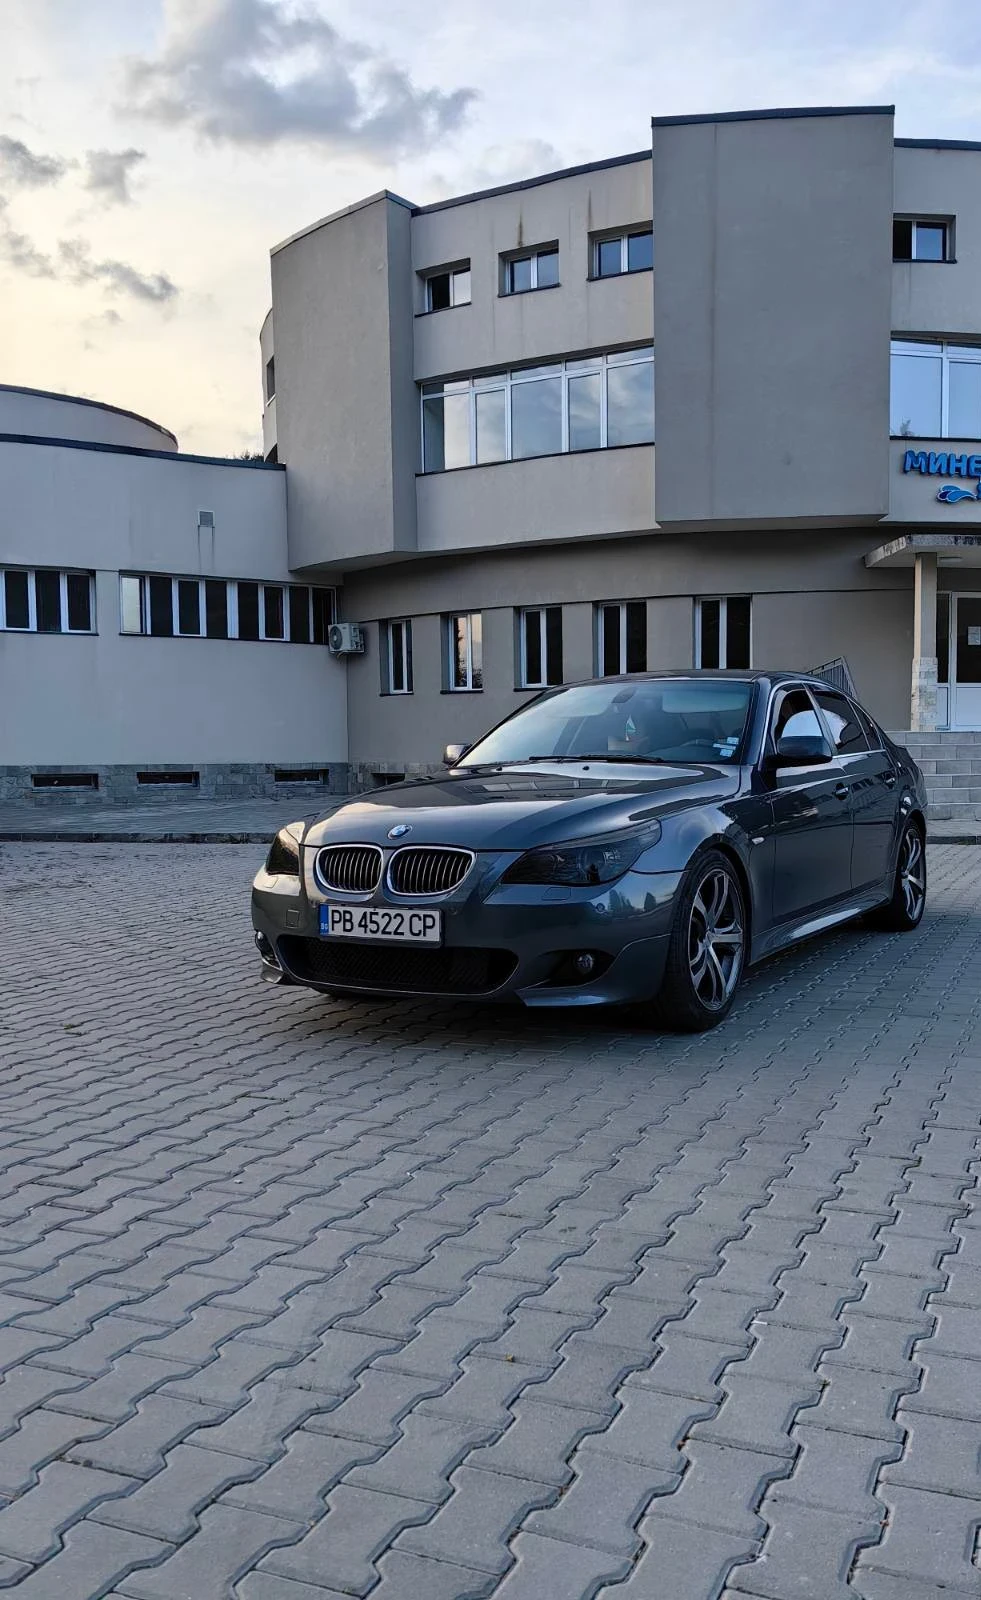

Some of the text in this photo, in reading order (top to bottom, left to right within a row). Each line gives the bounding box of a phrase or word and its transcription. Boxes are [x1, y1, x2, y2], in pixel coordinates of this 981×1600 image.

[331, 909, 435, 937] PB 4522 CP
